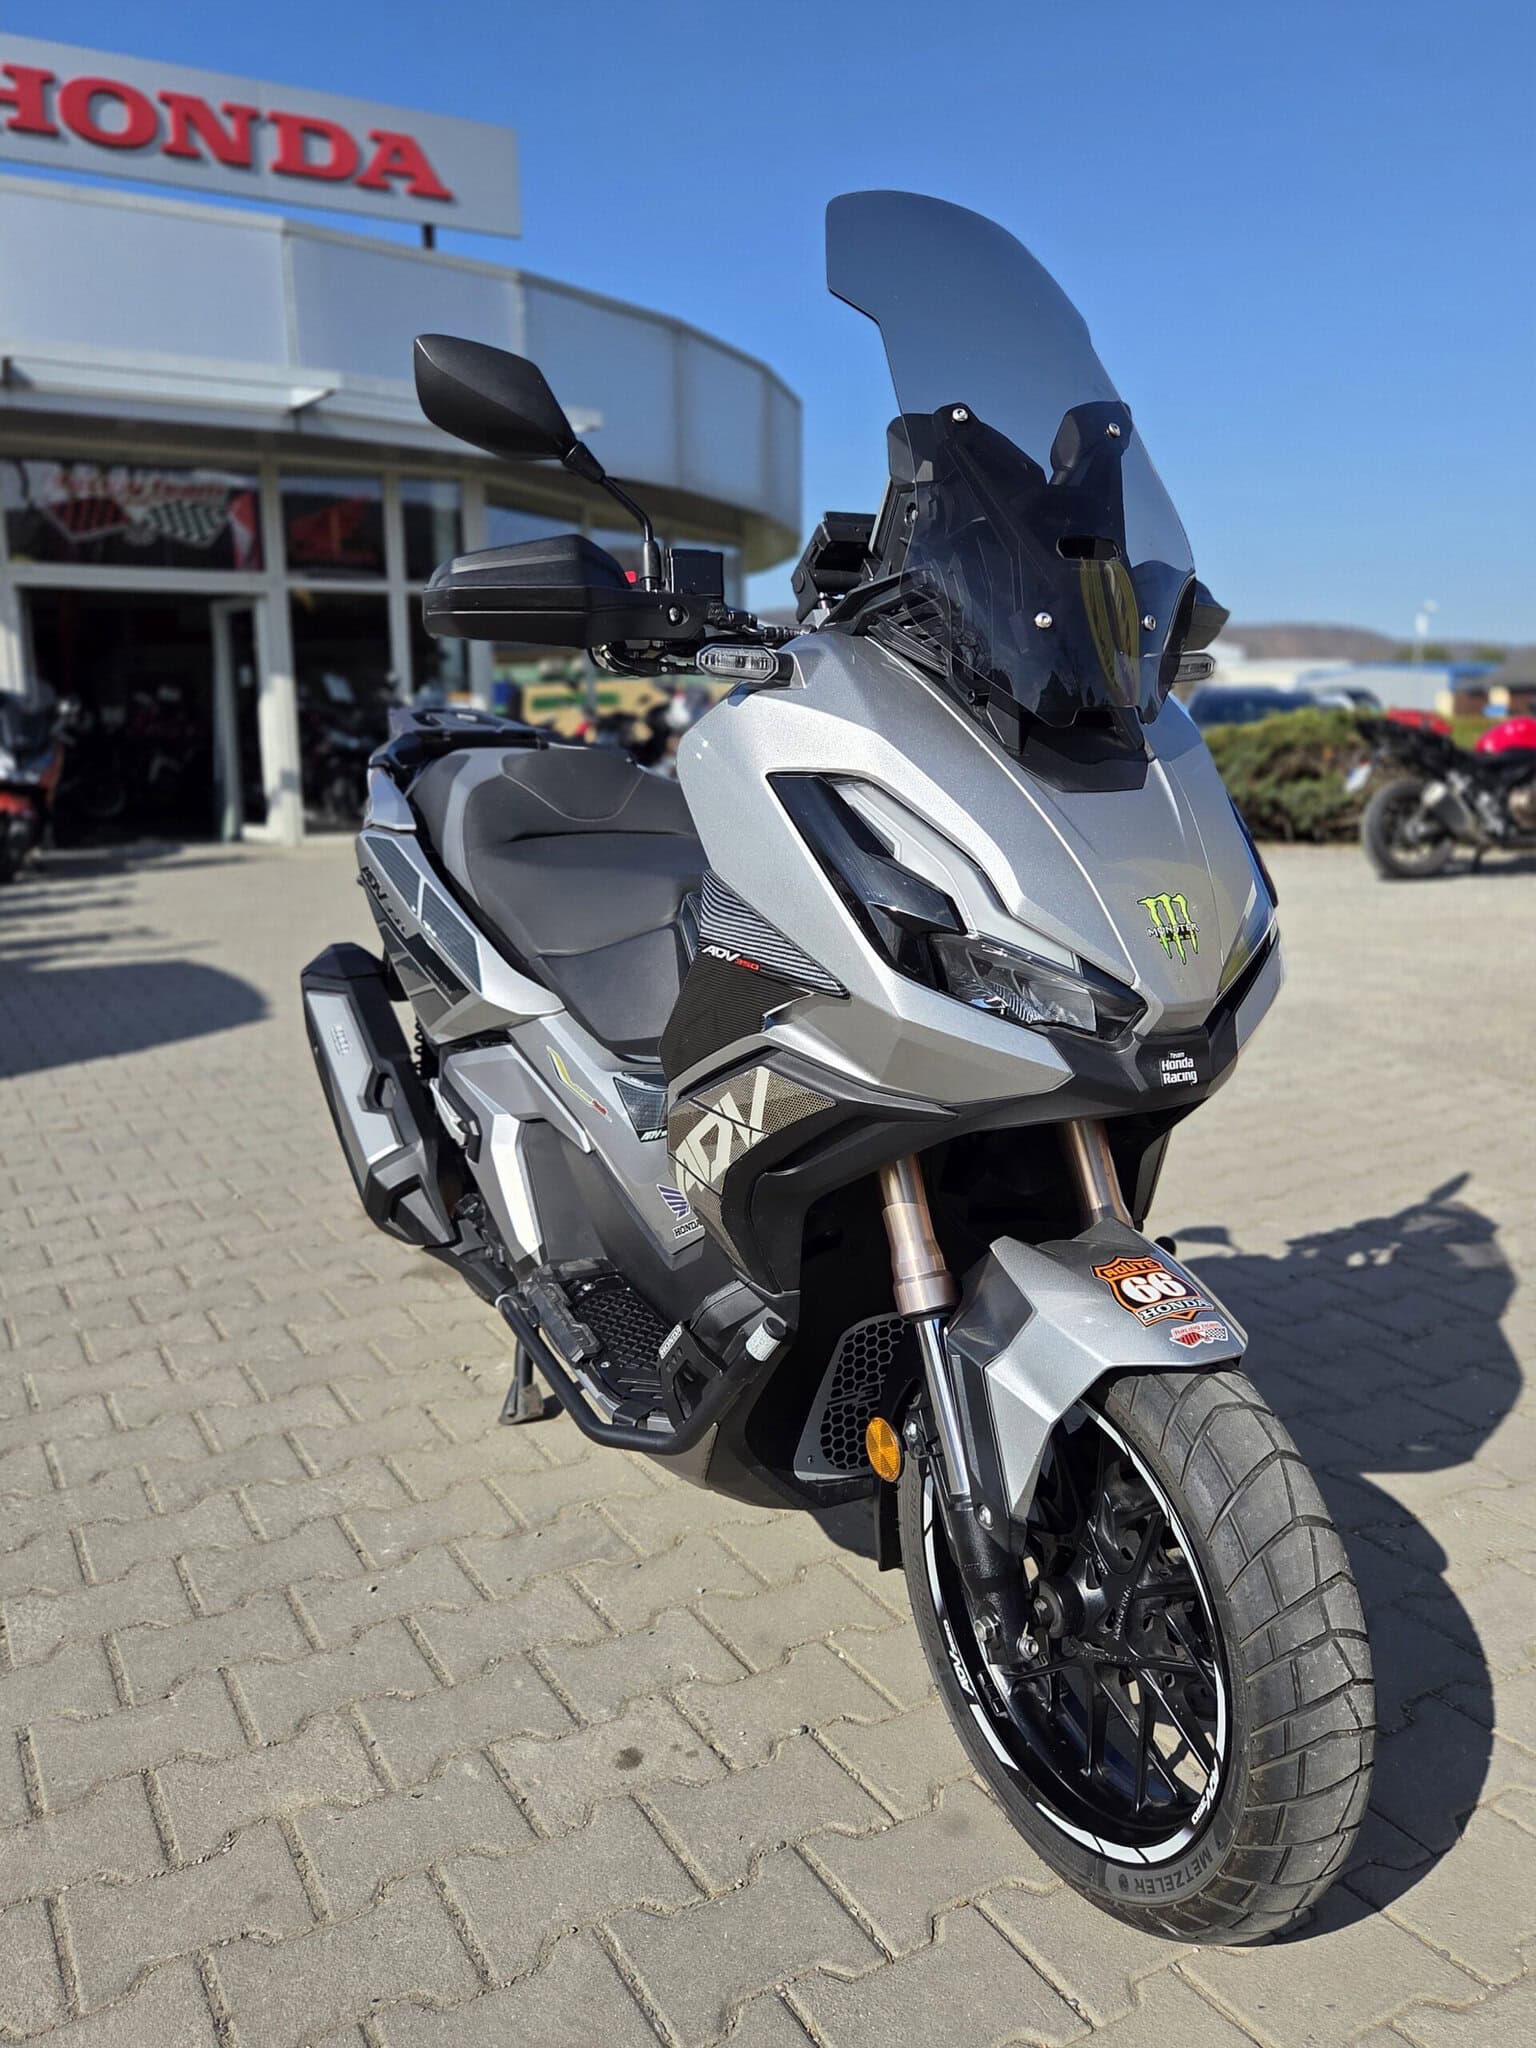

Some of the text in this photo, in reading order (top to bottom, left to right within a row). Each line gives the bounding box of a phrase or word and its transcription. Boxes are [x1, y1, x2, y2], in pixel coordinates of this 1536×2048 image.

[1161, 1057, 1194, 1072] Honda
[1163, 1070, 1198, 1086] Racing
[1103, 1260, 1158, 1278] ROUTE
[1120, 1271, 1187, 1303] 66
[1140, 1298, 1209, 1320] HONDA
[1133, 1847, 1214, 1895] METZELER
